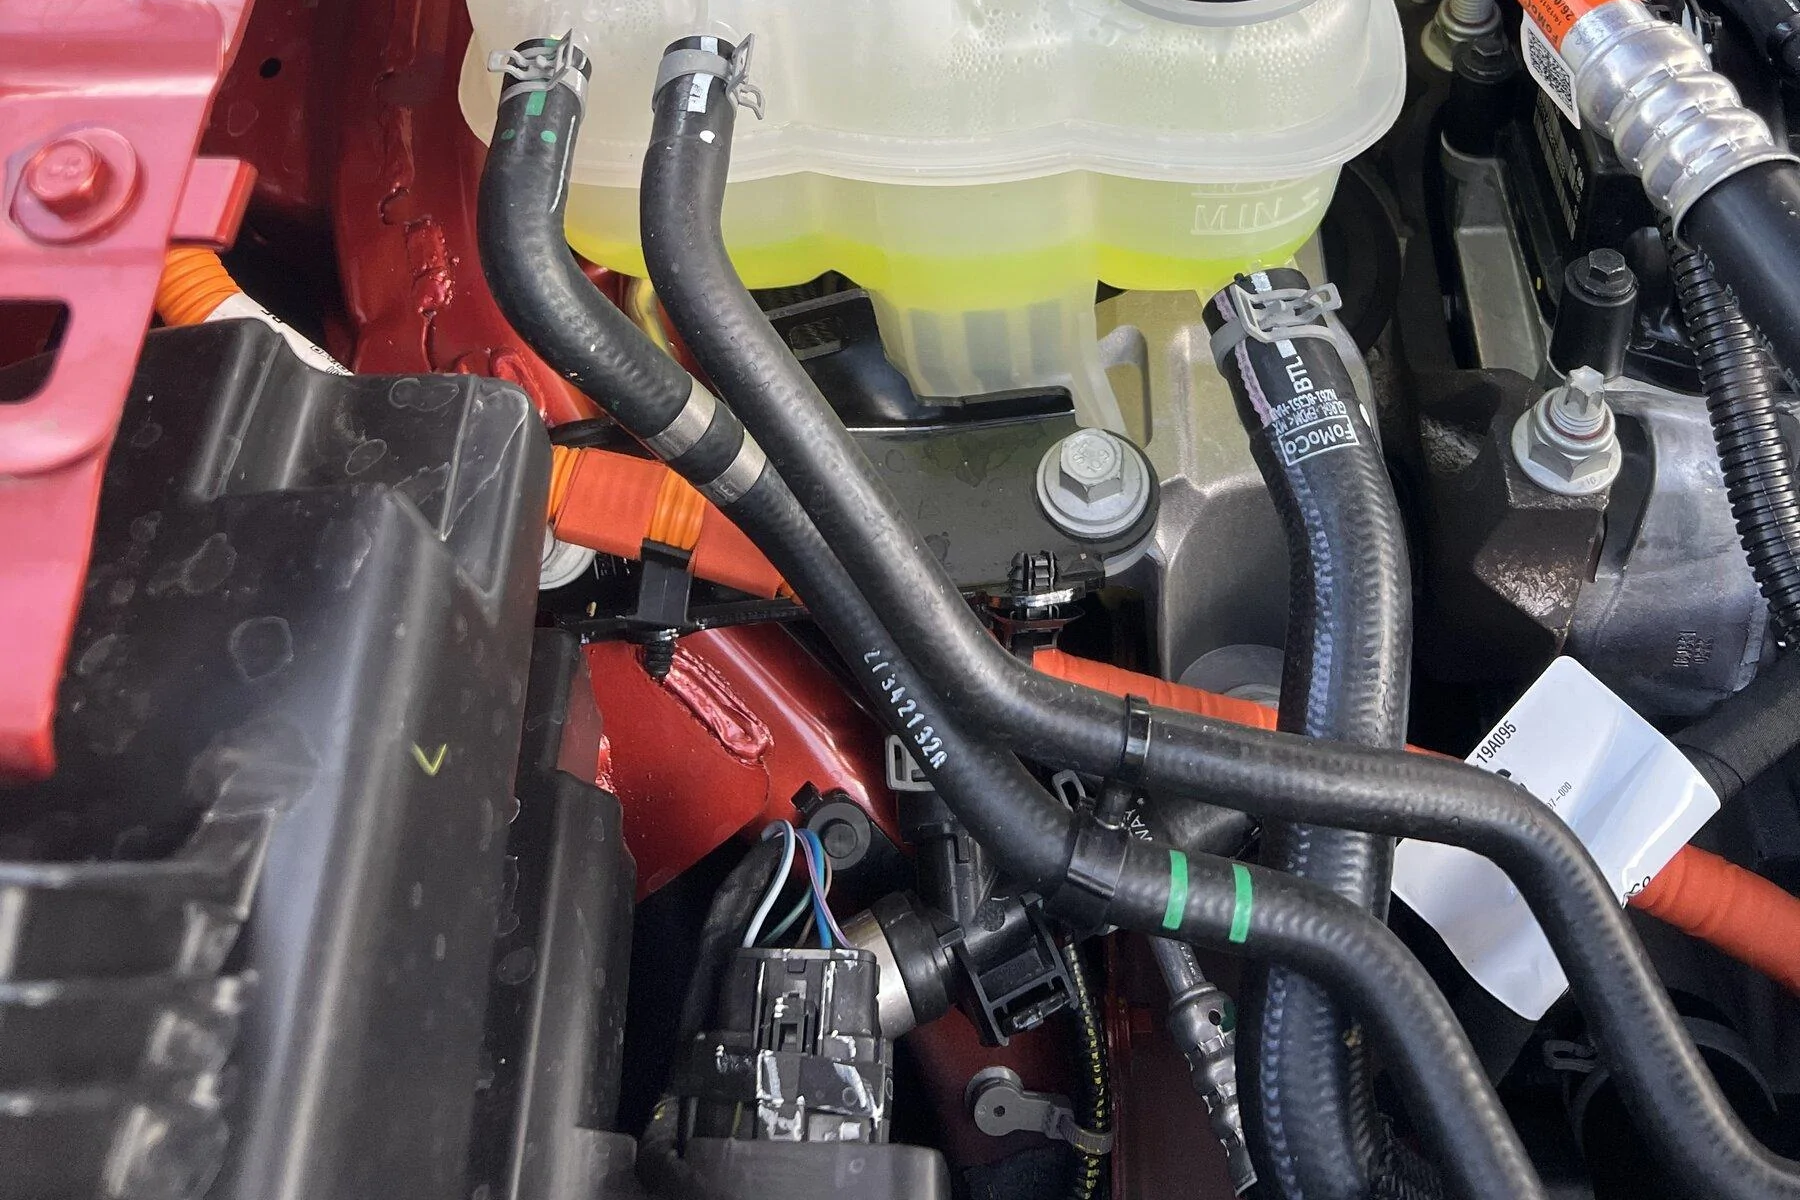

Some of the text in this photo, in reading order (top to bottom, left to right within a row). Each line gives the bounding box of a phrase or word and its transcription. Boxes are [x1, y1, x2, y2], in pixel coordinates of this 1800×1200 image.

[1194, 196, 1283, 231] MIN
[1286, 355, 1314, 394] BTL
[1284, 422, 1355, 455] FoMoCo
[1476, 720, 1517, 764] 19A095
